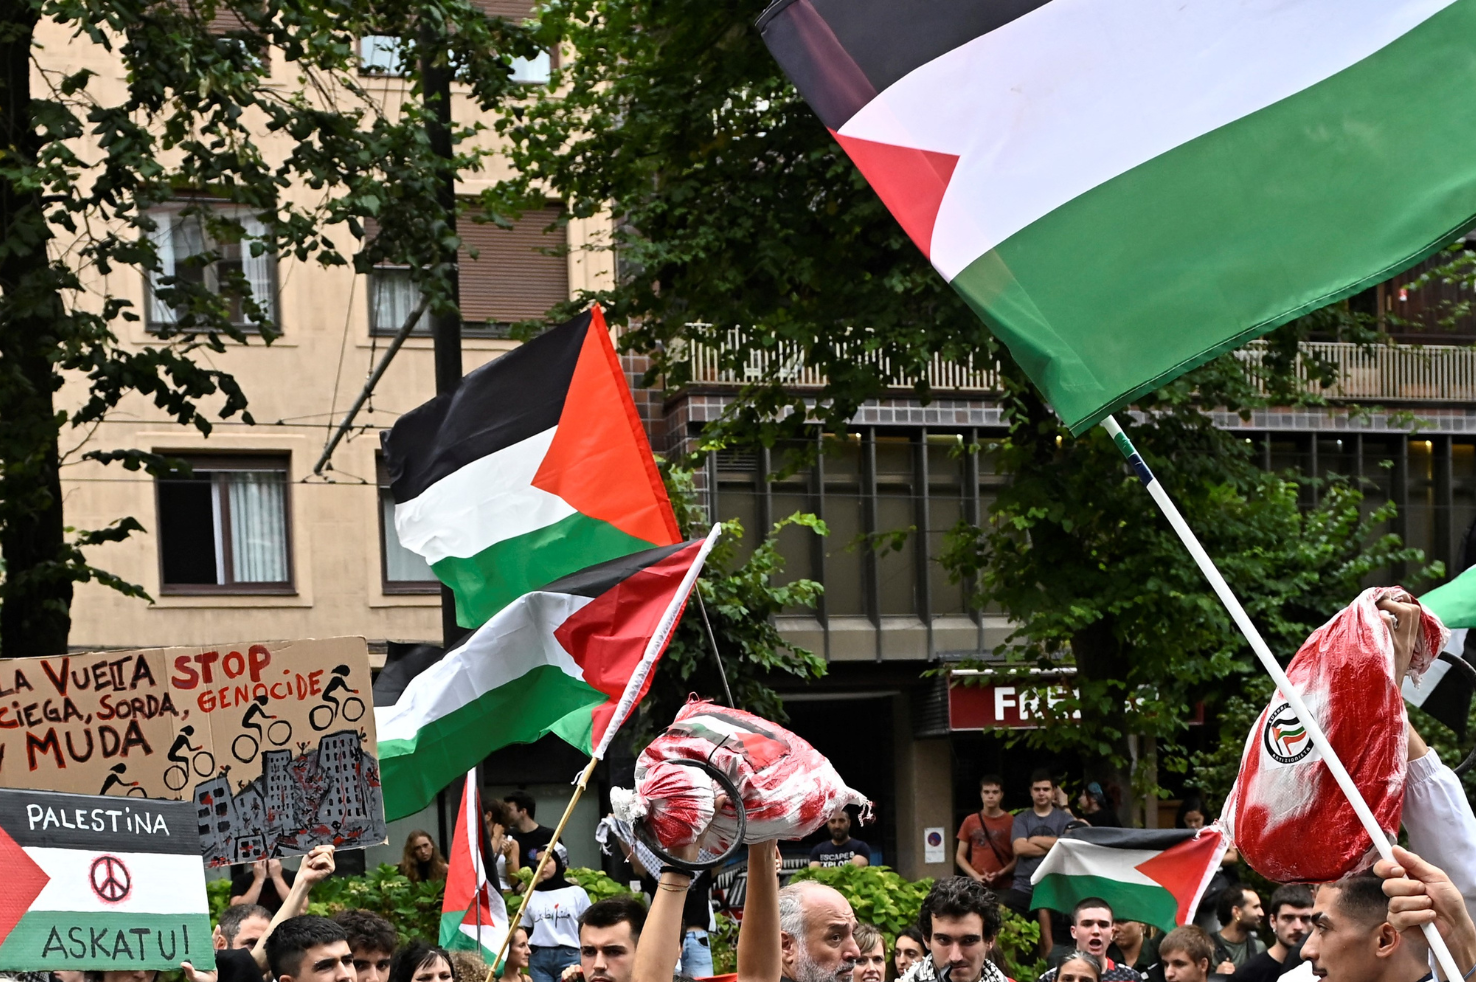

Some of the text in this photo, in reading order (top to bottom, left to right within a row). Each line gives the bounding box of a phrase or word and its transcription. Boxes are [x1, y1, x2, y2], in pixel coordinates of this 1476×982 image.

[0, 644, 271, 697] LA VUELTA STOP
[26, 719, 153, 771] MUDA
[41, 924, 191, 962] ASKATU!
